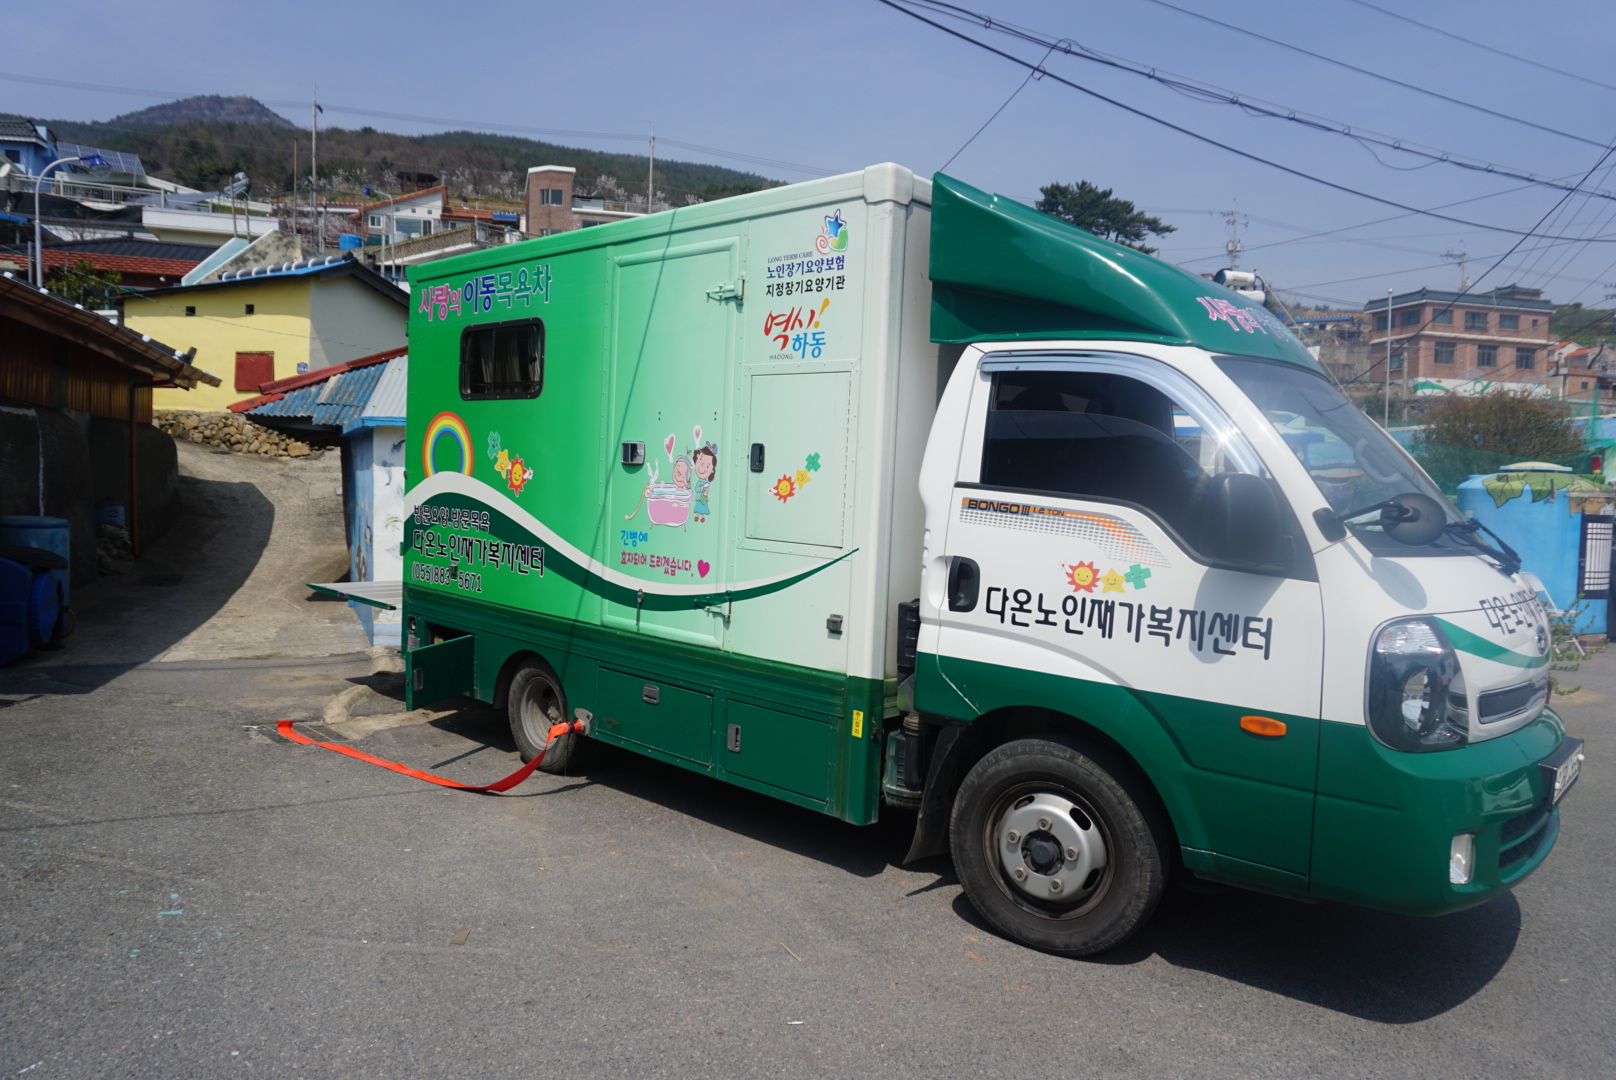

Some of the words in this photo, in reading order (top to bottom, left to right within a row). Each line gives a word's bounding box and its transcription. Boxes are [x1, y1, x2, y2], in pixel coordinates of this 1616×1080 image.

[766, 255, 845, 279] 노인장기요양보험
[767, 256, 782, 264] LONG
[783, 253, 798, 261] TERM
[799, 251, 813, 259] CARE
[766, 275, 845, 298] 지정장기요양기관
[418, 283, 462, 321] 사랑의
[792, 331, 826, 359] 하동
[620, 530, 648, 547] 긴병에
[412, 530, 545, 577] 다온노인재가복지센터
[620, 550, 647, 565] 효자되어
[985, 586, 1273, 660] 다온노인재가복지센터
